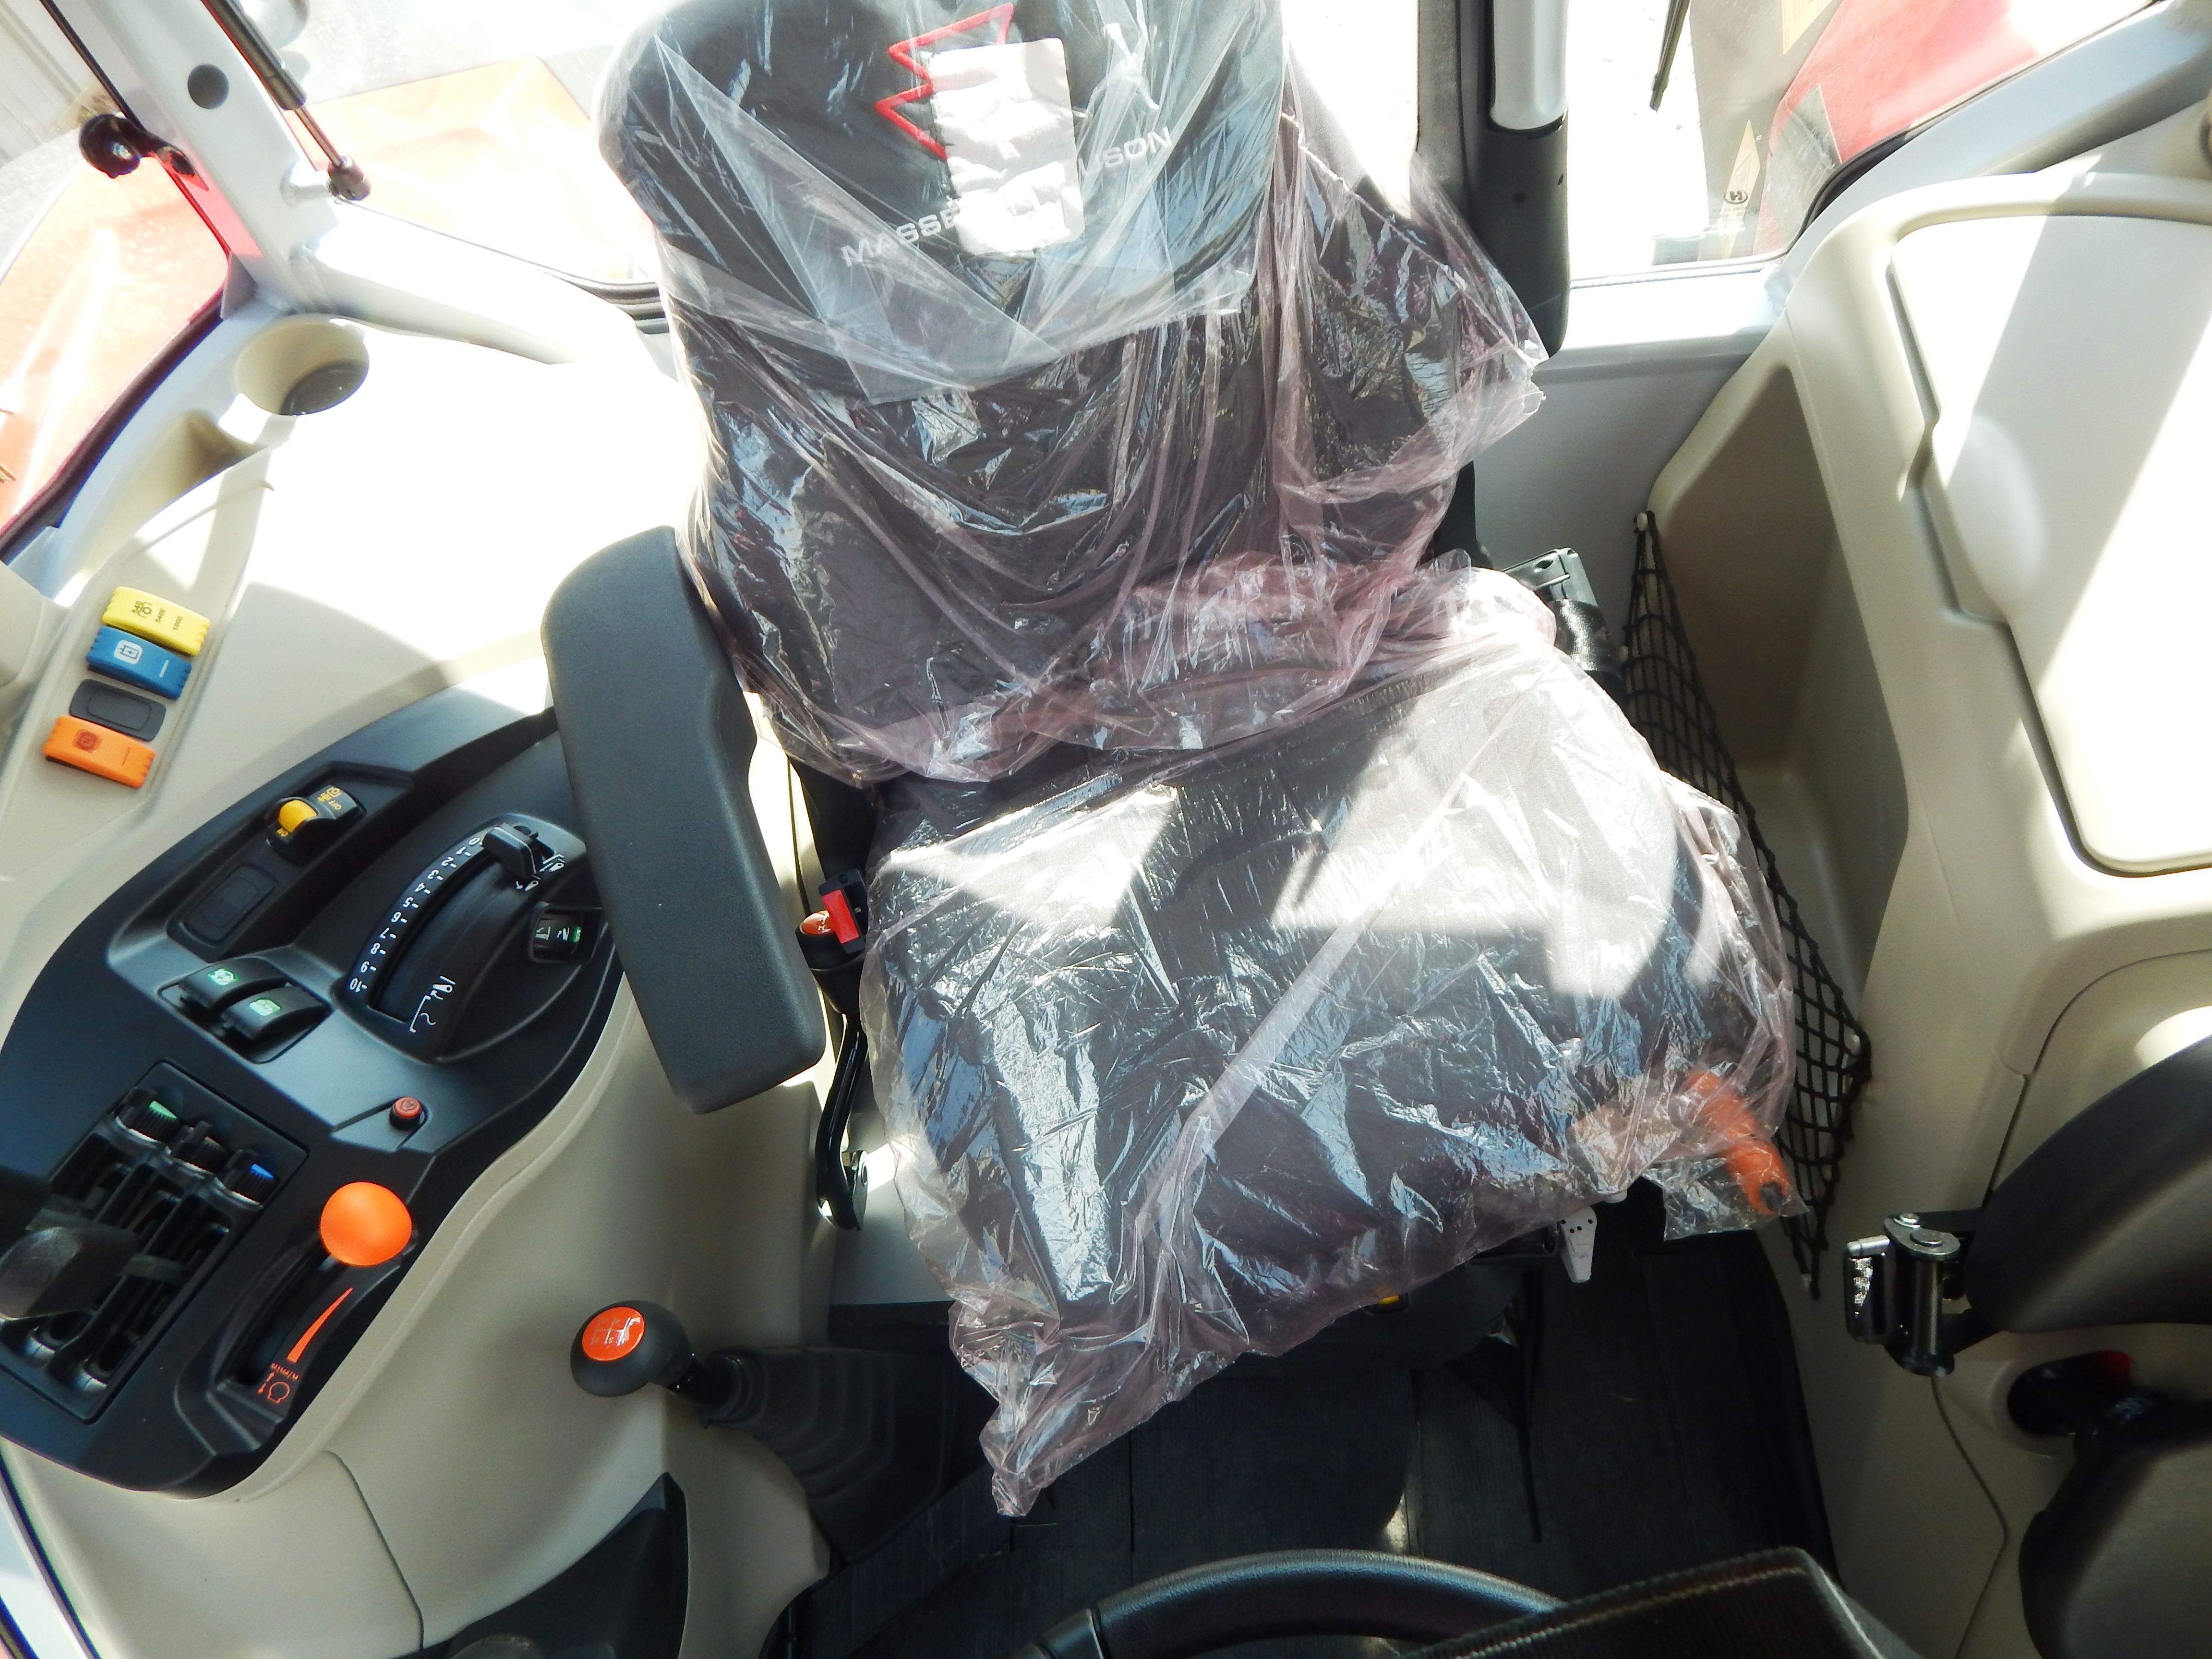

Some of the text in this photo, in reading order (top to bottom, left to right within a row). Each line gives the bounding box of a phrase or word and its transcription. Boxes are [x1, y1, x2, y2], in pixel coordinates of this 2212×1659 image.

[841, 207, 960, 267] MASSE
[173, 615, 183, 630] 1000
[328, 800, 342, 810] OFF
[456, 846, 466, 854] 1
[442, 856, 454, 866] 2
[428, 869, 439, 879] 3
[415, 882, 425, 892] 4
[403, 897, 414, 908] 5
[391, 912, 401, 923] 6
[380, 927, 390, 939] 7
[371, 943, 381, 954] 8
[361, 961, 370, 973] 9
[350, 978, 362, 992] 10
[271, 1363, 299, 1380] n/min
